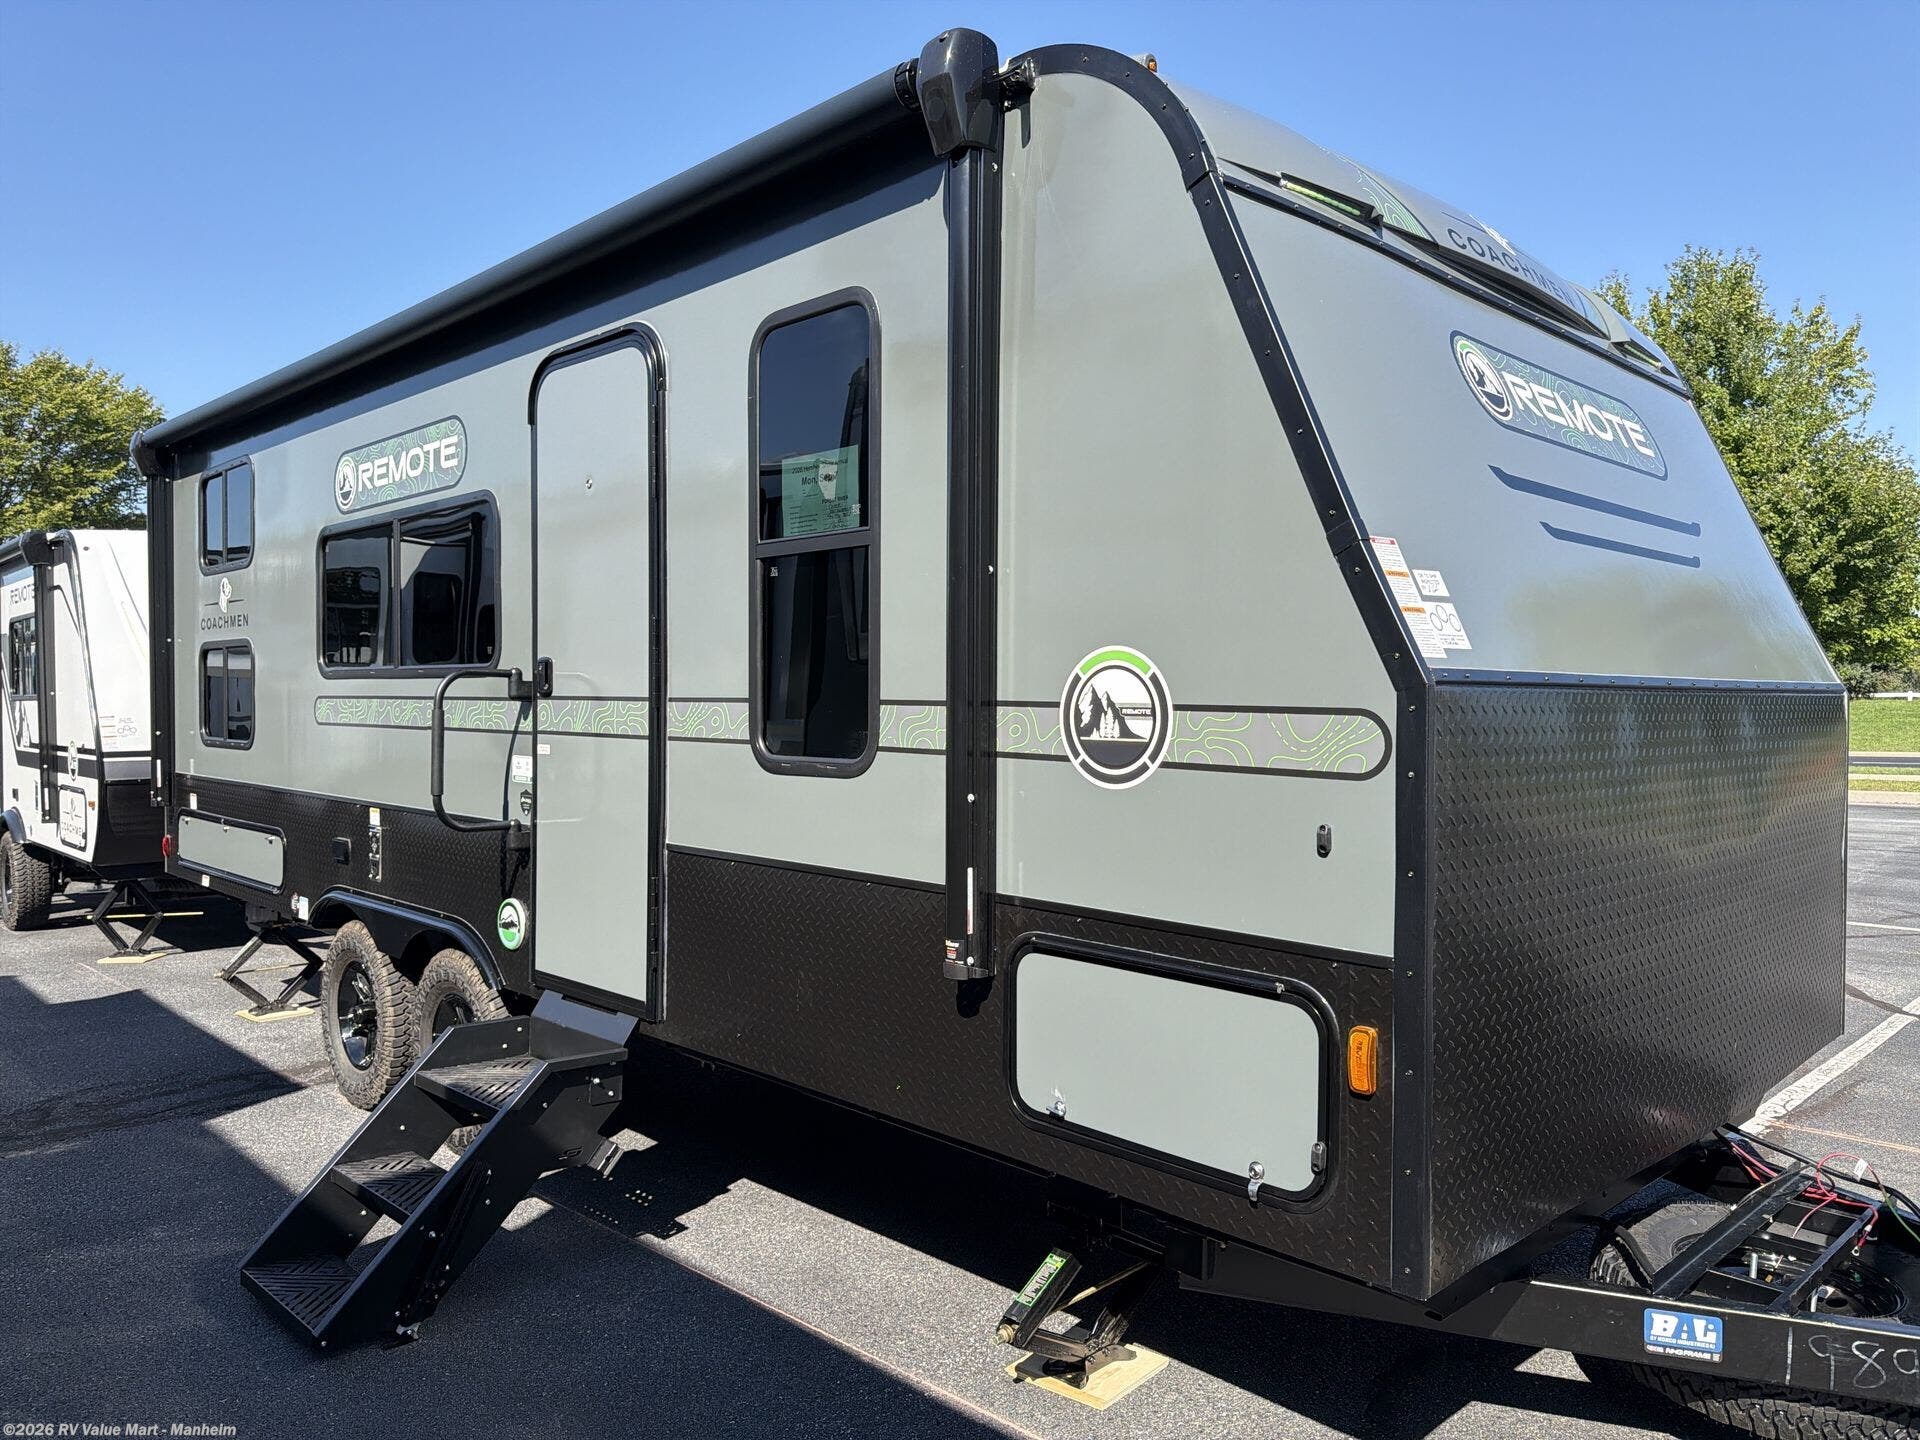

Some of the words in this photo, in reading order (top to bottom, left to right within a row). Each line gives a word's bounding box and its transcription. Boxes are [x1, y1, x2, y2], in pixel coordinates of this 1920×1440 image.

[1447, 228, 1578, 309] COACHMEN
[1502, 371, 1656, 458] REMOTE
[357, 434, 459, 492] REMOTE
[200, 613, 249, 631] COACHMEN
